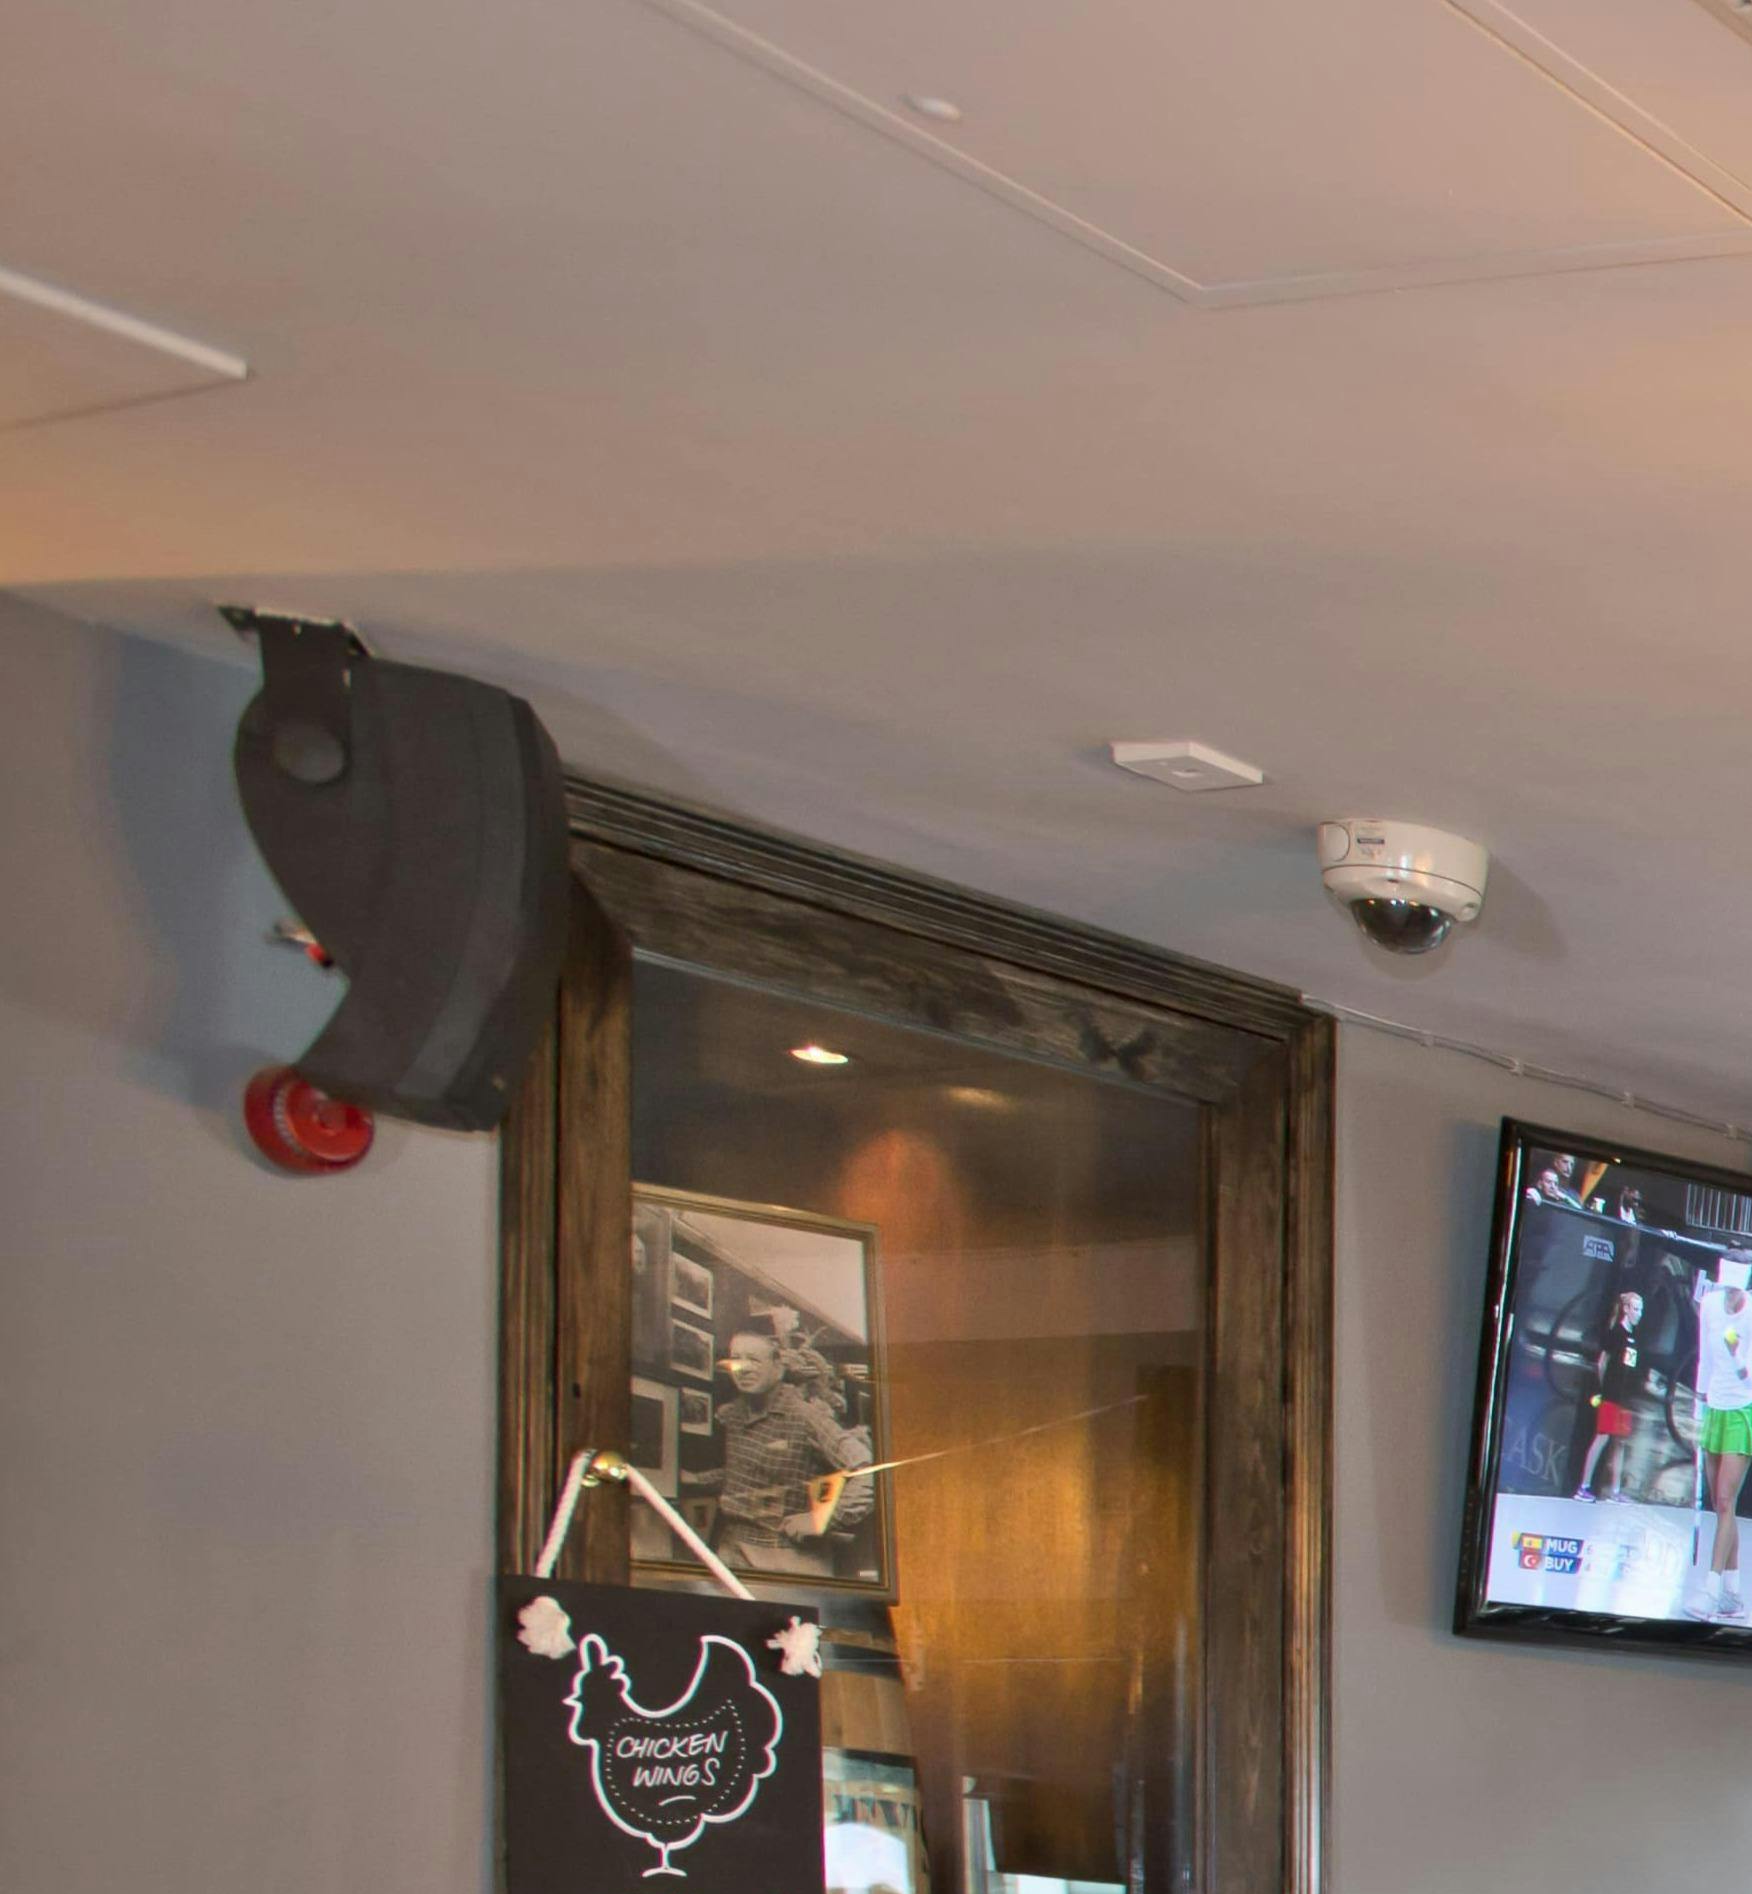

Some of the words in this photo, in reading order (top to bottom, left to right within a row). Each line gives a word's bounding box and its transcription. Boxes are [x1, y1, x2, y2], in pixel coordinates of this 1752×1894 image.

[1545, 1537, 1578, 1554] MUG
[1544, 1556, 1575, 1572] BUY
[616, 1730, 728, 1759] CHICKEN
[633, 1757, 720, 1787] WINGS
